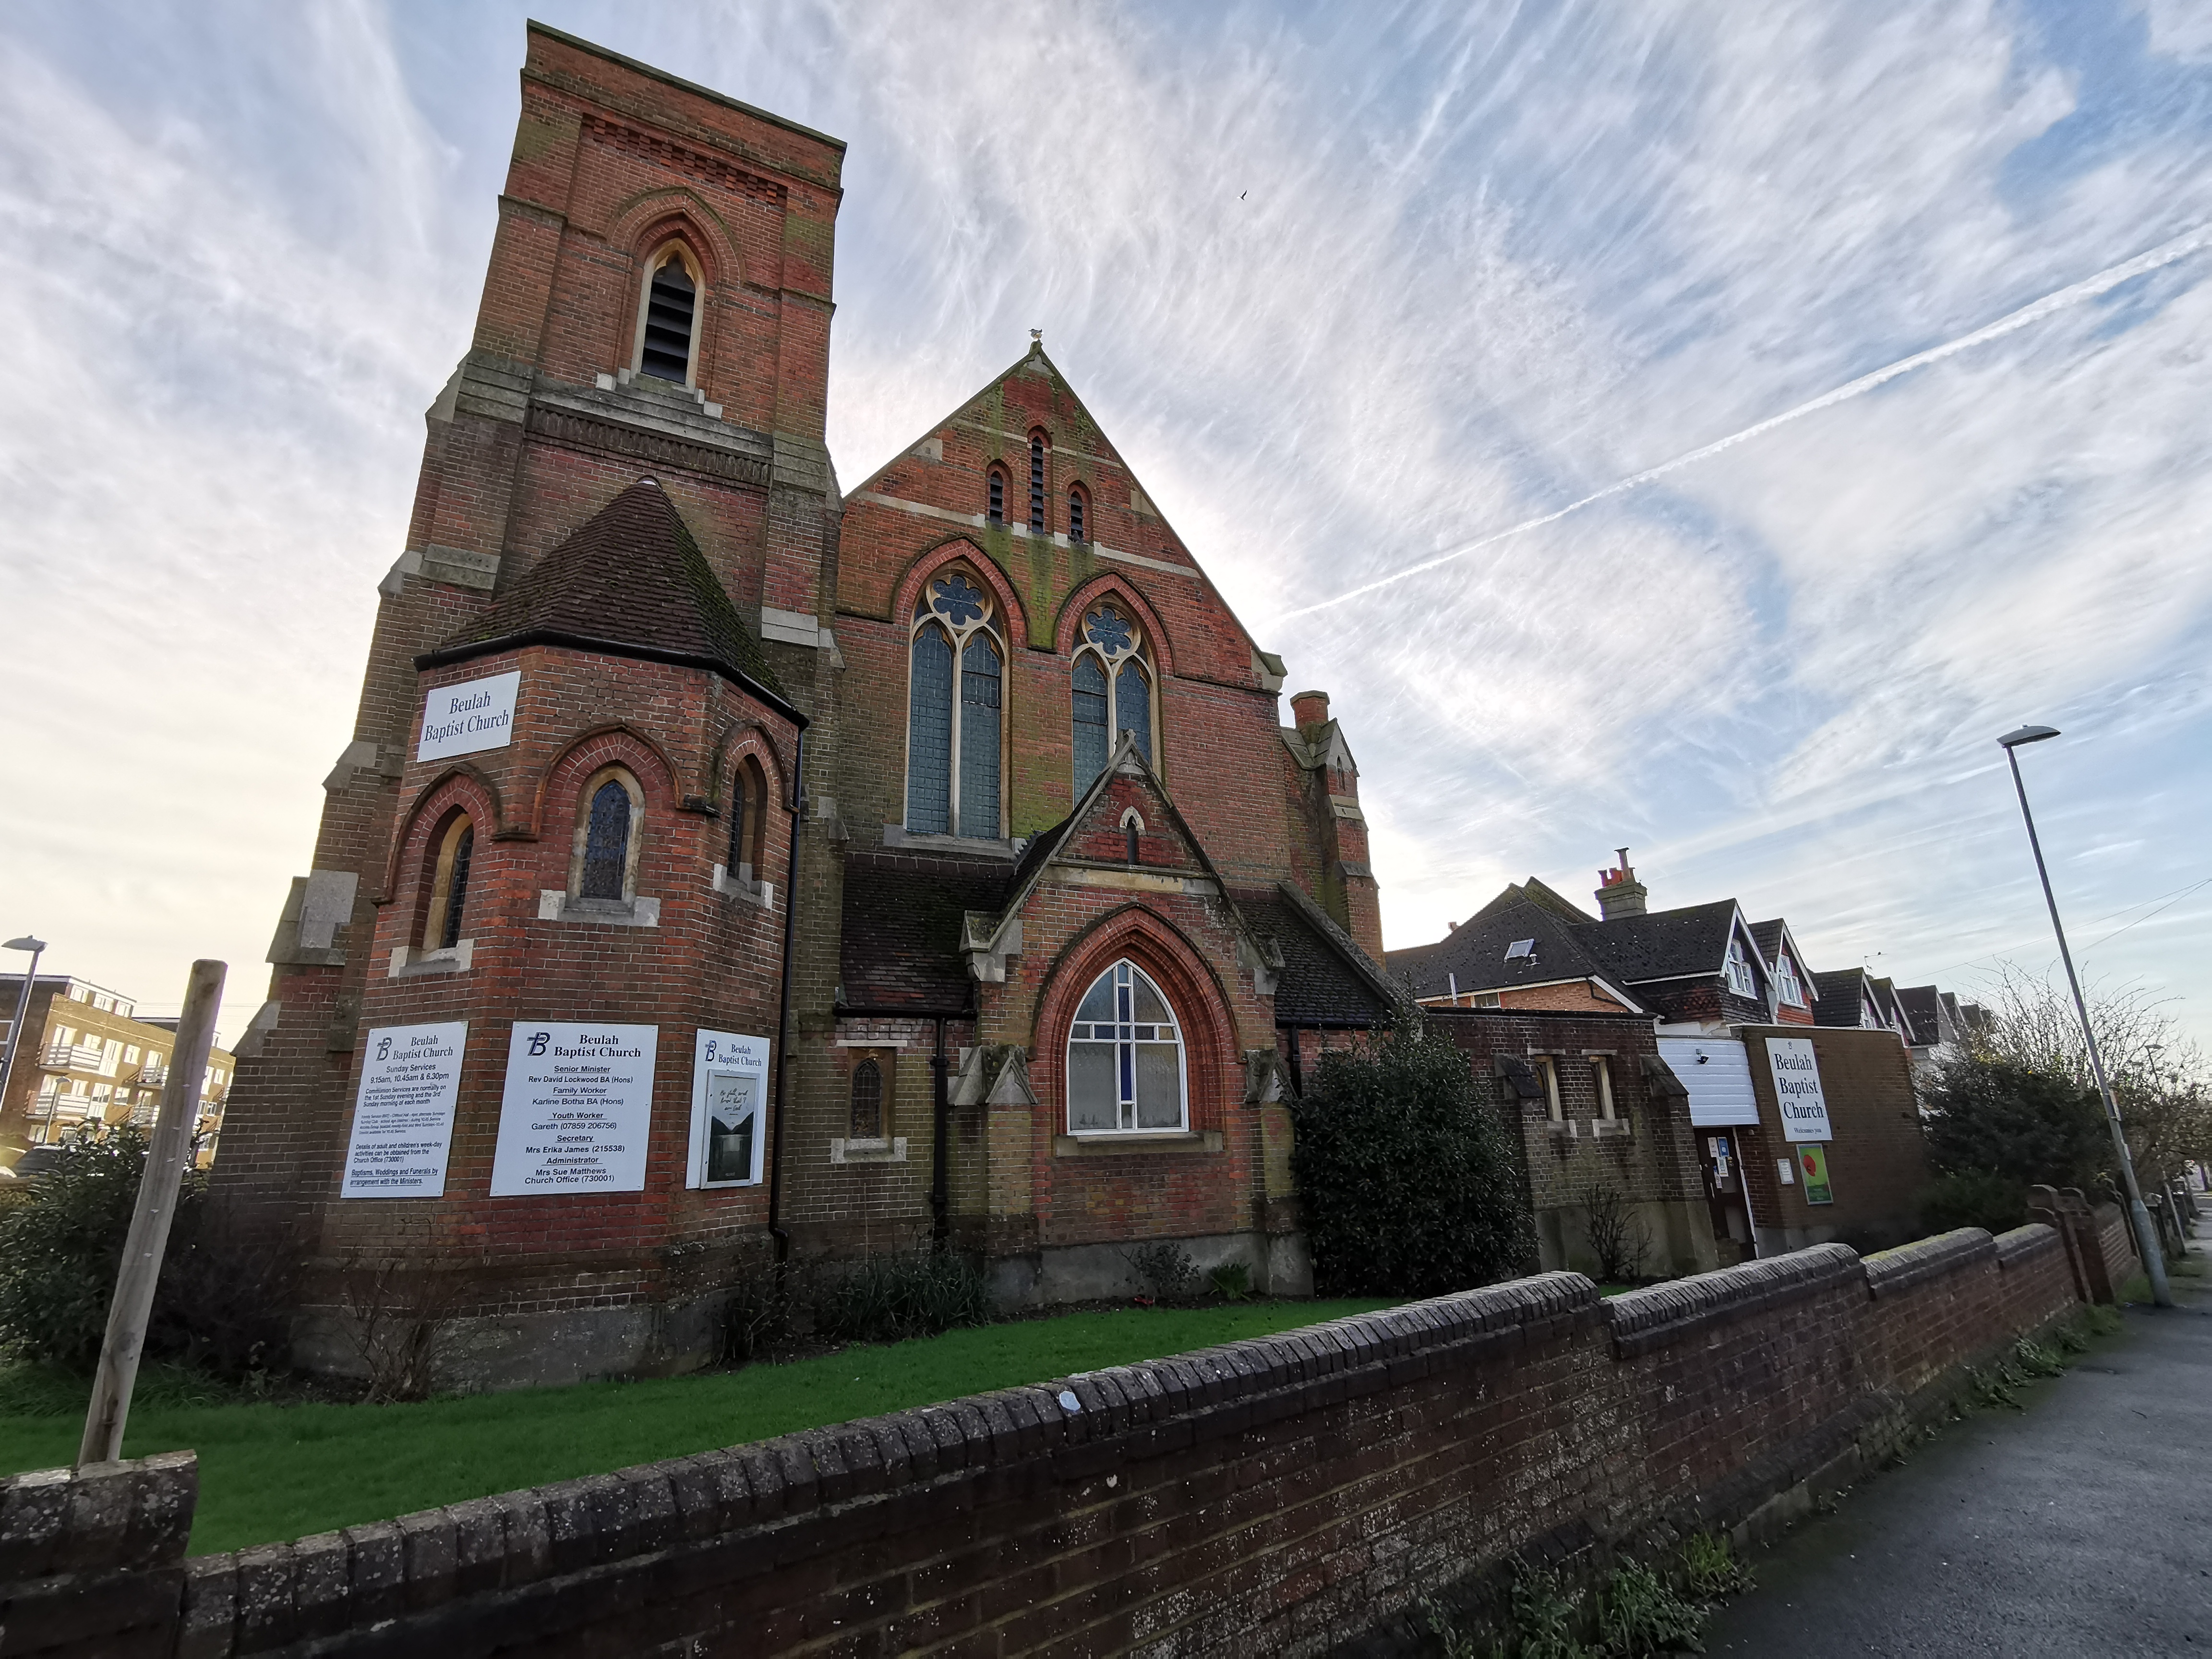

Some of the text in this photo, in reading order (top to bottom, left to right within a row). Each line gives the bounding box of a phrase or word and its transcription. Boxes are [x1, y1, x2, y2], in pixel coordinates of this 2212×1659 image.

[449, 691, 491, 714] Beulah
[424, 709, 509, 743] Baptist Church
[410, 1035, 438, 1046] Beulah
[579, 1034, 619, 1045] Beulah
[393, 1046, 453, 1061] Baptist Church
[554, 1046, 641, 1059] Baptist Church
[731, 1044, 751, 1054] Beulah
[719, 1054, 761, 1066] Baptist Church
[1774, 1053, 1813, 1070] Beulah
[386, 1063, 436, 1073] Sunday Services
[426, 1073, 449, 1082] 6.30pm
[1779, 1077, 1818, 1098] Baptist
[1783, 1101, 1825, 1119] Church
[561, 1122, 586, 1130] (07859
[588, 1122, 617, 1130] 206756)
[592, 1145, 625, 1154] (215538)
[432, 1167, 438, 1176] by
[581, 1175, 614, 1183] (730001)
